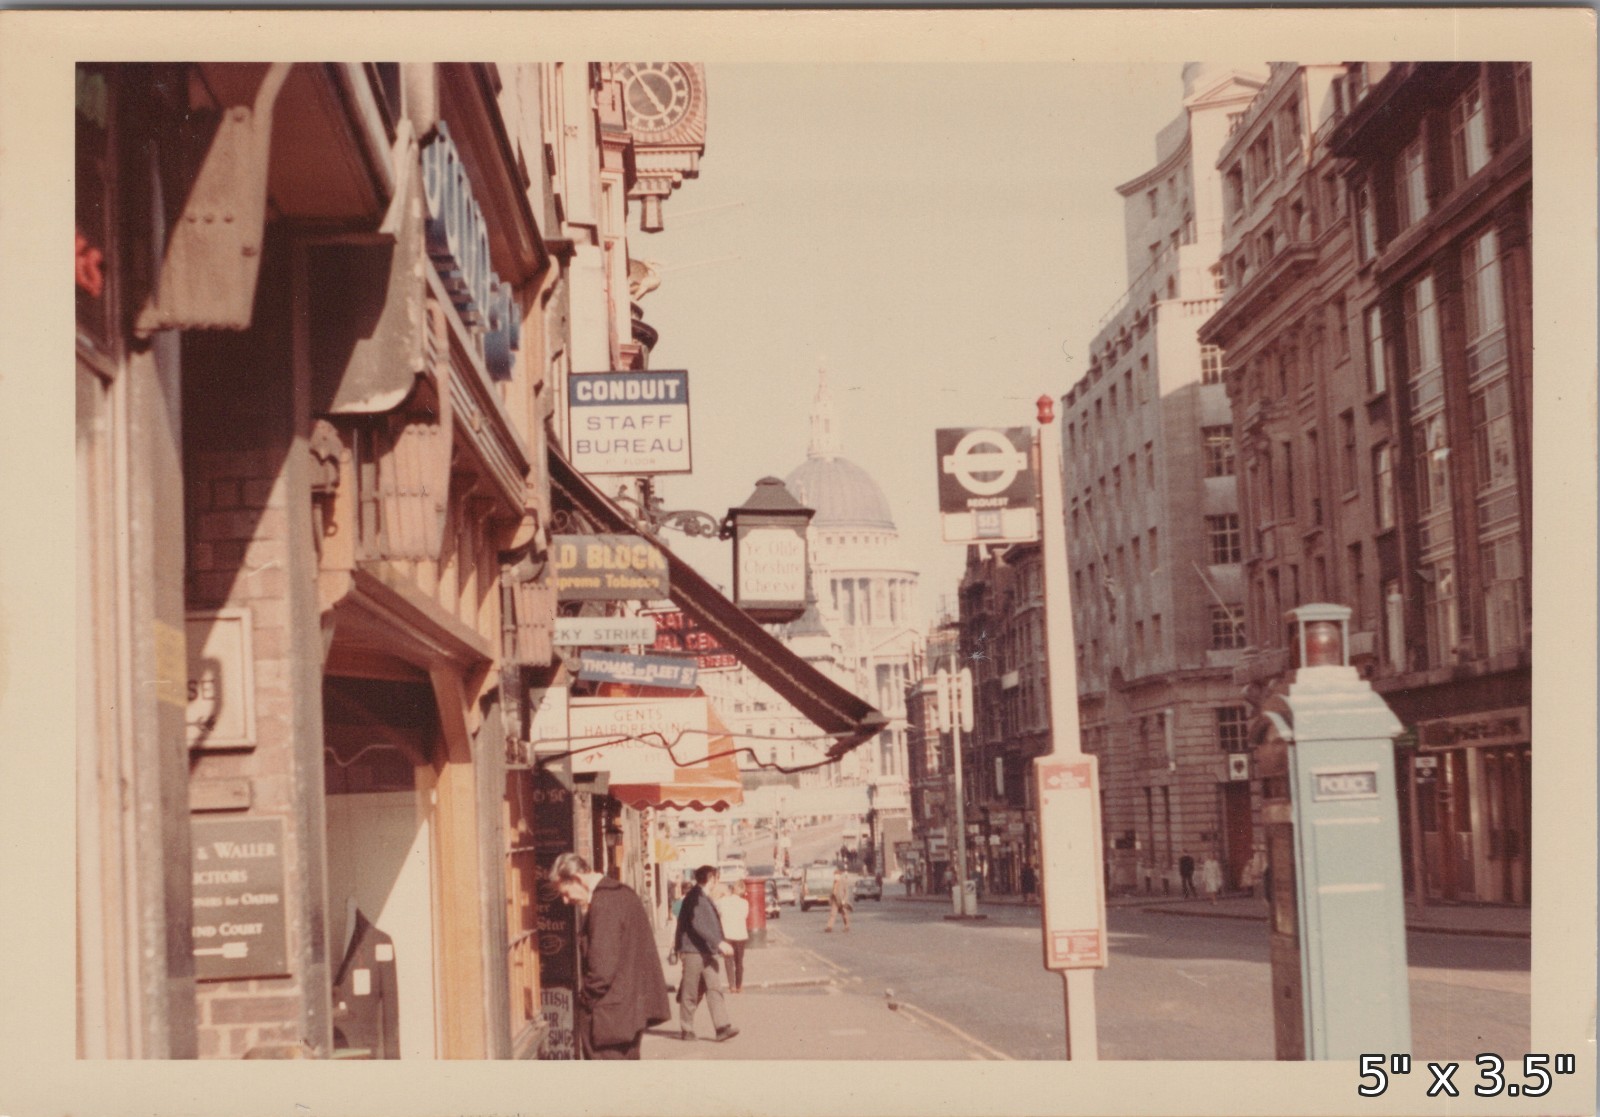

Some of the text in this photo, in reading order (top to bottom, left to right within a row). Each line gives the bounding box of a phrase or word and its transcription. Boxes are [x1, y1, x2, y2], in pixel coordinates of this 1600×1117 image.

[577, 379, 680, 401] CONDUIT
[587, 415, 672, 430] STAFF
[576, 438, 683, 454] BUREAU
[586, 542, 666, 570] BLOCK
[769, 540, 799, 556] Olde
[744, 559, 801, 575] Cheshire
[605, 573, 660, 588] Tobacco
[744, 578, 797, 593] Cheese
[593, 627, 650, 641] STRIKE
[582, 659, 634, 675] THOMAS
[645, 664, 680, 680] FLEET
[698, 655, 736, 668] ENSED
[188, 679, 215, 701] SE
[613, 708, 663, 722] GENTS
[584, 720, 691, 737] HAIRDRESSING
[1319, 774, 1370, 793] POLICE
[196, 847, 209, 860] &
[192, 870, 248, 885] ICITORS
[536, 916, 567, 931] Star
[542, 991, 570, 1012] TISH
